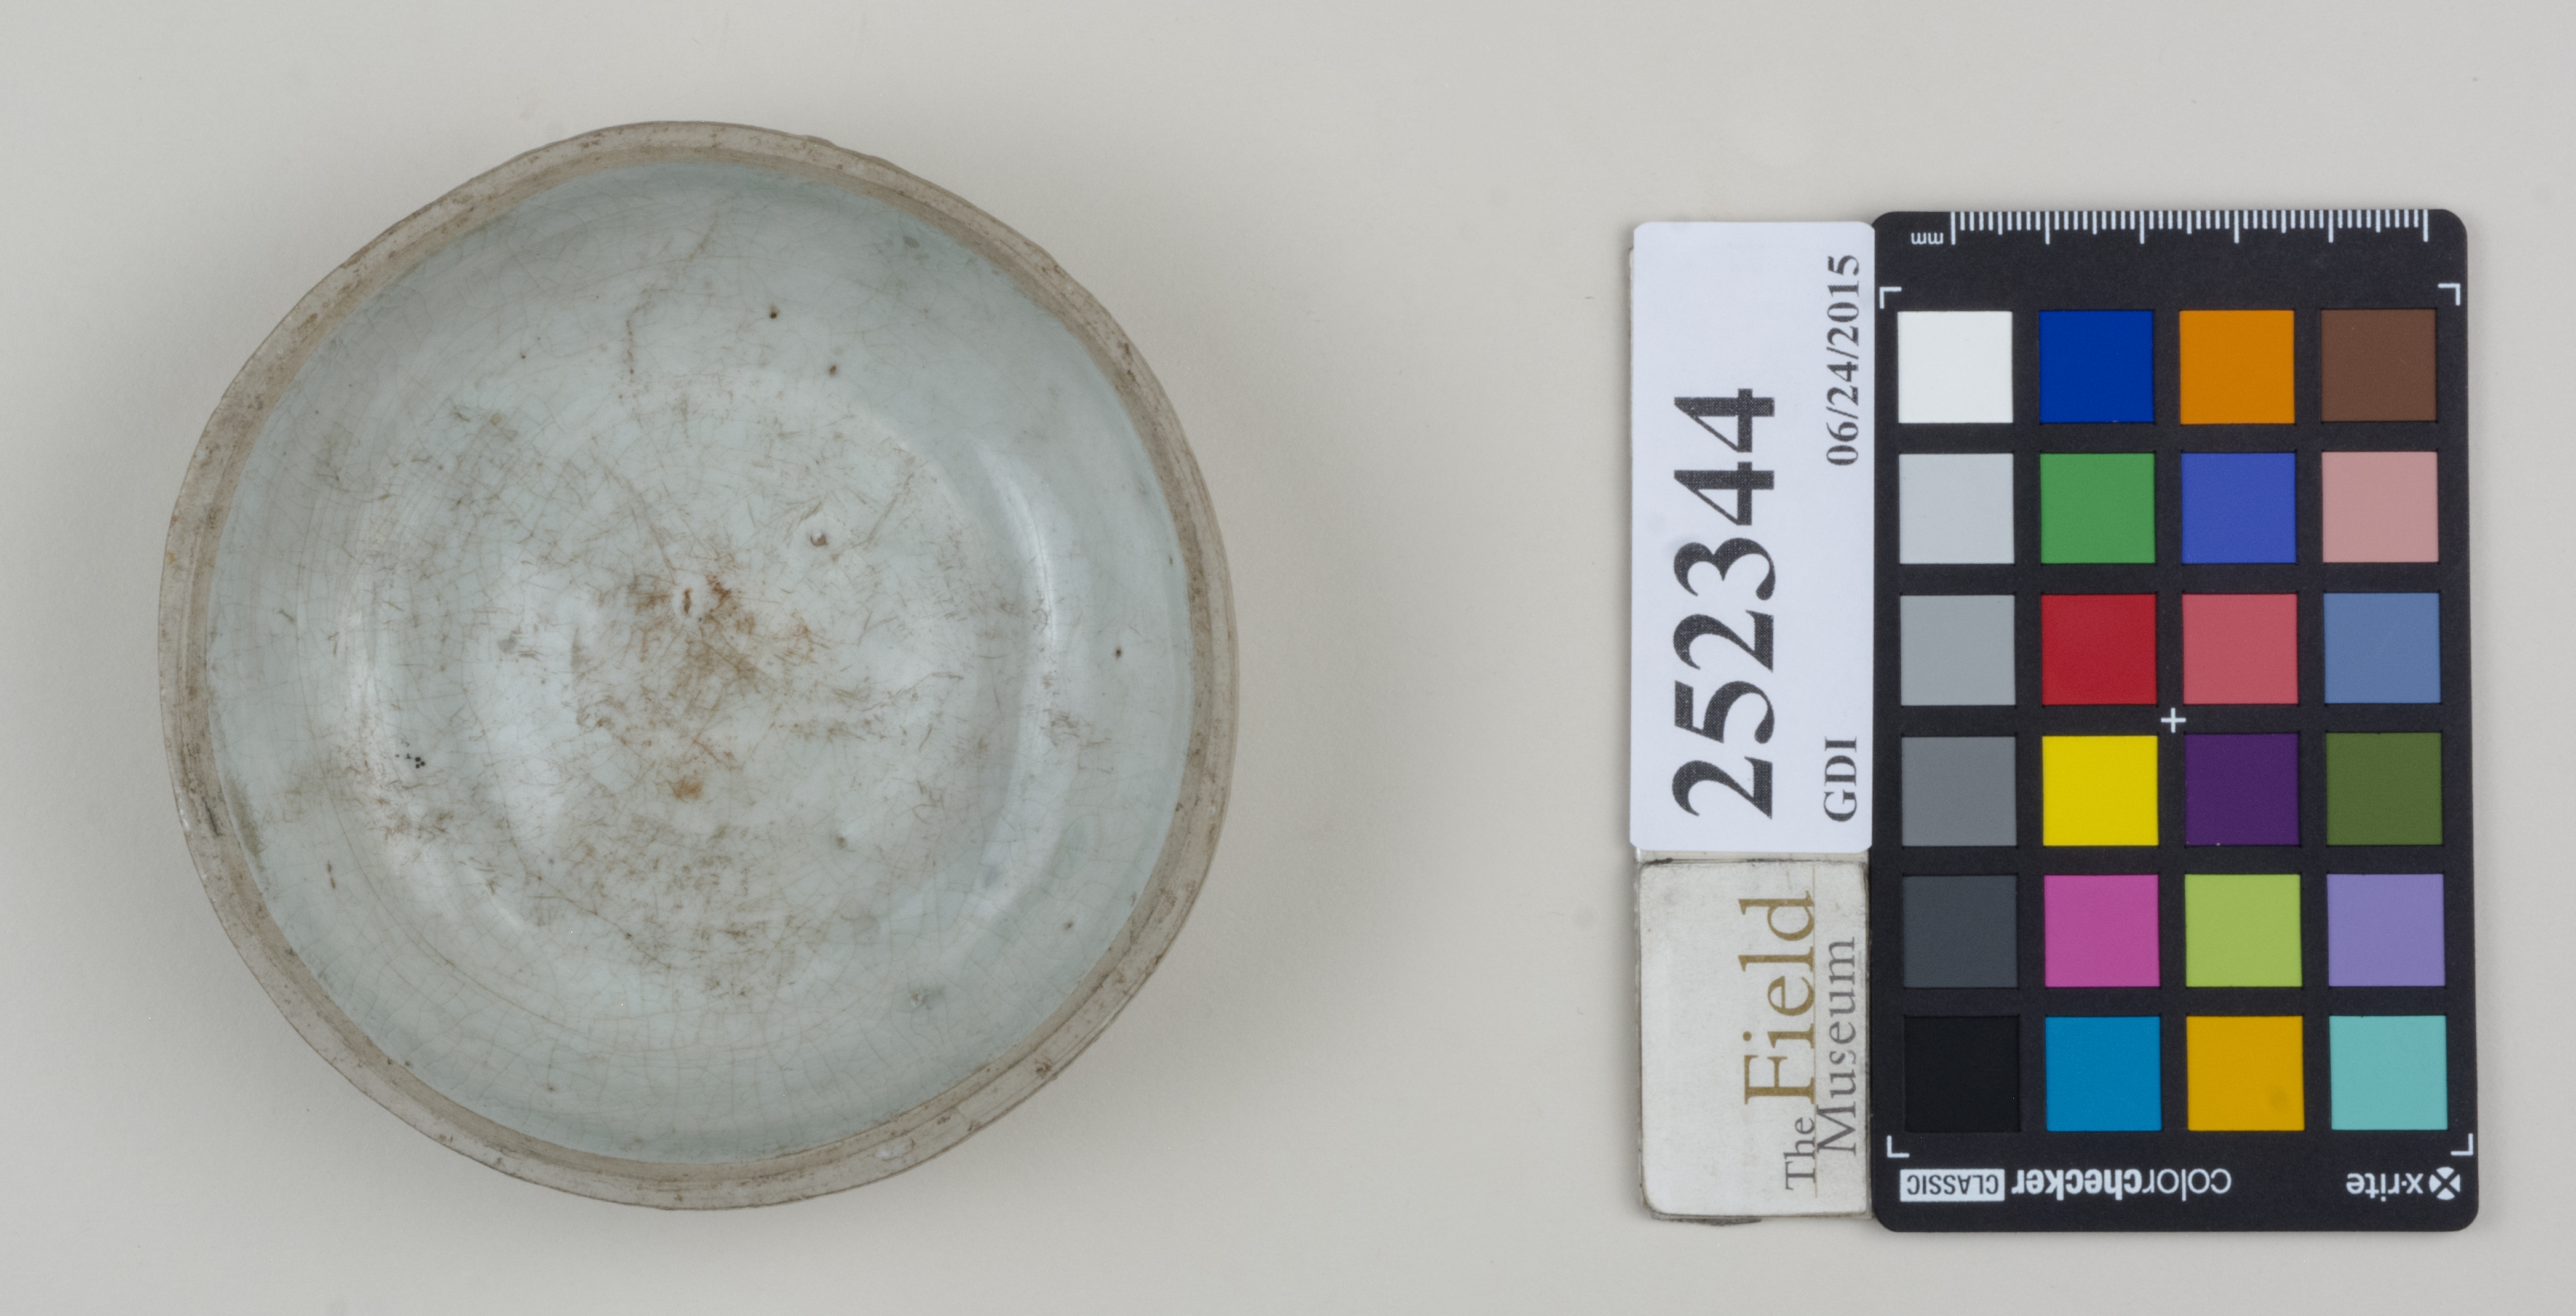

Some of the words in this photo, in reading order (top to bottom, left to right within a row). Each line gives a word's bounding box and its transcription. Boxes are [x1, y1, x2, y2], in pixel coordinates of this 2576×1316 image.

[1910, 232, 1944, 245] mm
[1826, 254, 1860, 466] 06/24/2015
[1672, 388, 1775, 819] 252344
[1824, 737, 1858, 823] GDI
[1739, 891, 1815, 1105] Field
[1816, 938, 1856, 1156] Museum
[1784, 1117, 1815, 1190] The
[1906, 1174, 1999, 1197] CLASSIC
[2011, 1168, 2232, 1201] colorchecker
